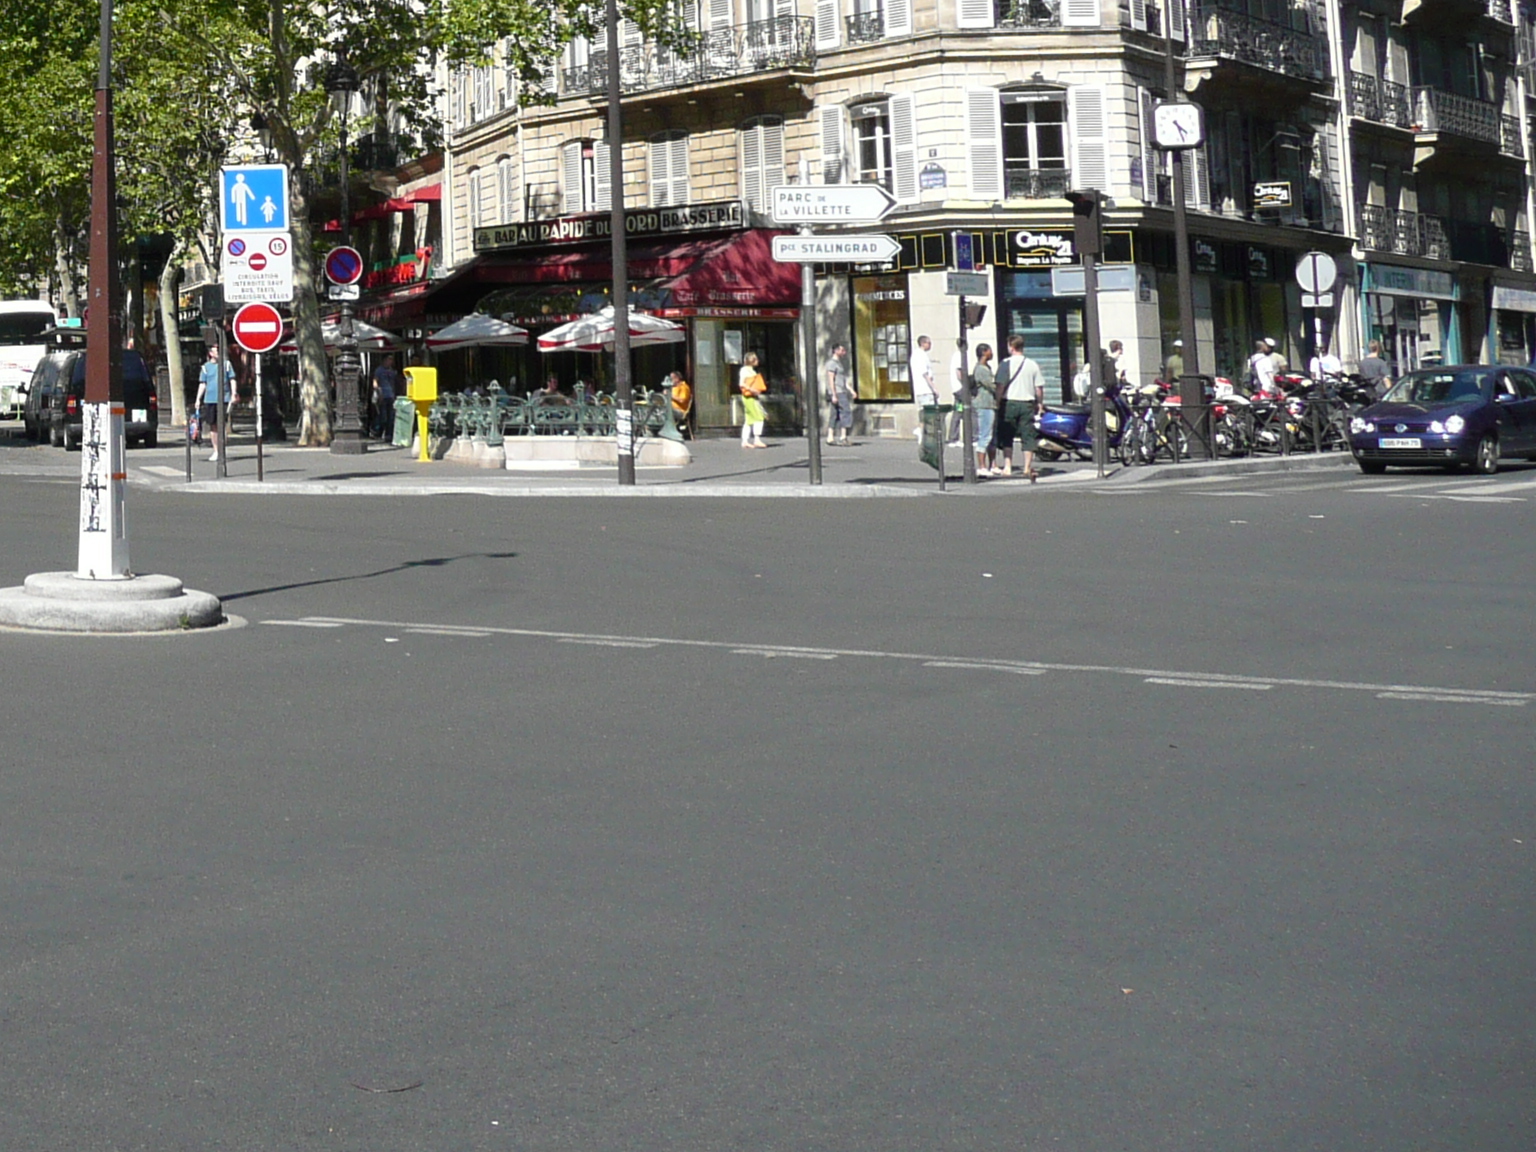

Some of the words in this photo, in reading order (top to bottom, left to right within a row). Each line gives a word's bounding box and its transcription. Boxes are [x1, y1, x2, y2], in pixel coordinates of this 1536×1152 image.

[779, 193, 812, 202] PARC
[793, 206, 852, 215] VILLETTE
[494, 229, 516, 244] BAR
[518, 225, 537, 242] AU
[540, 219, 593, 241] RAPIDE
[596, 220, 612, 236] DU
[625, 213, 658, 232] ORD
[661, 206, 740, 228] BRASSERIE
[273, 243, 283, 251] 15
[801, 243, 878, 253] STALINGRAD
[1015, 231, 1063, 249] Century
[1056, 239, 1074, 257] 21
[708, 289, 755, 301] Brasserie
[696, 308, 762, 316] BRASSERIE
